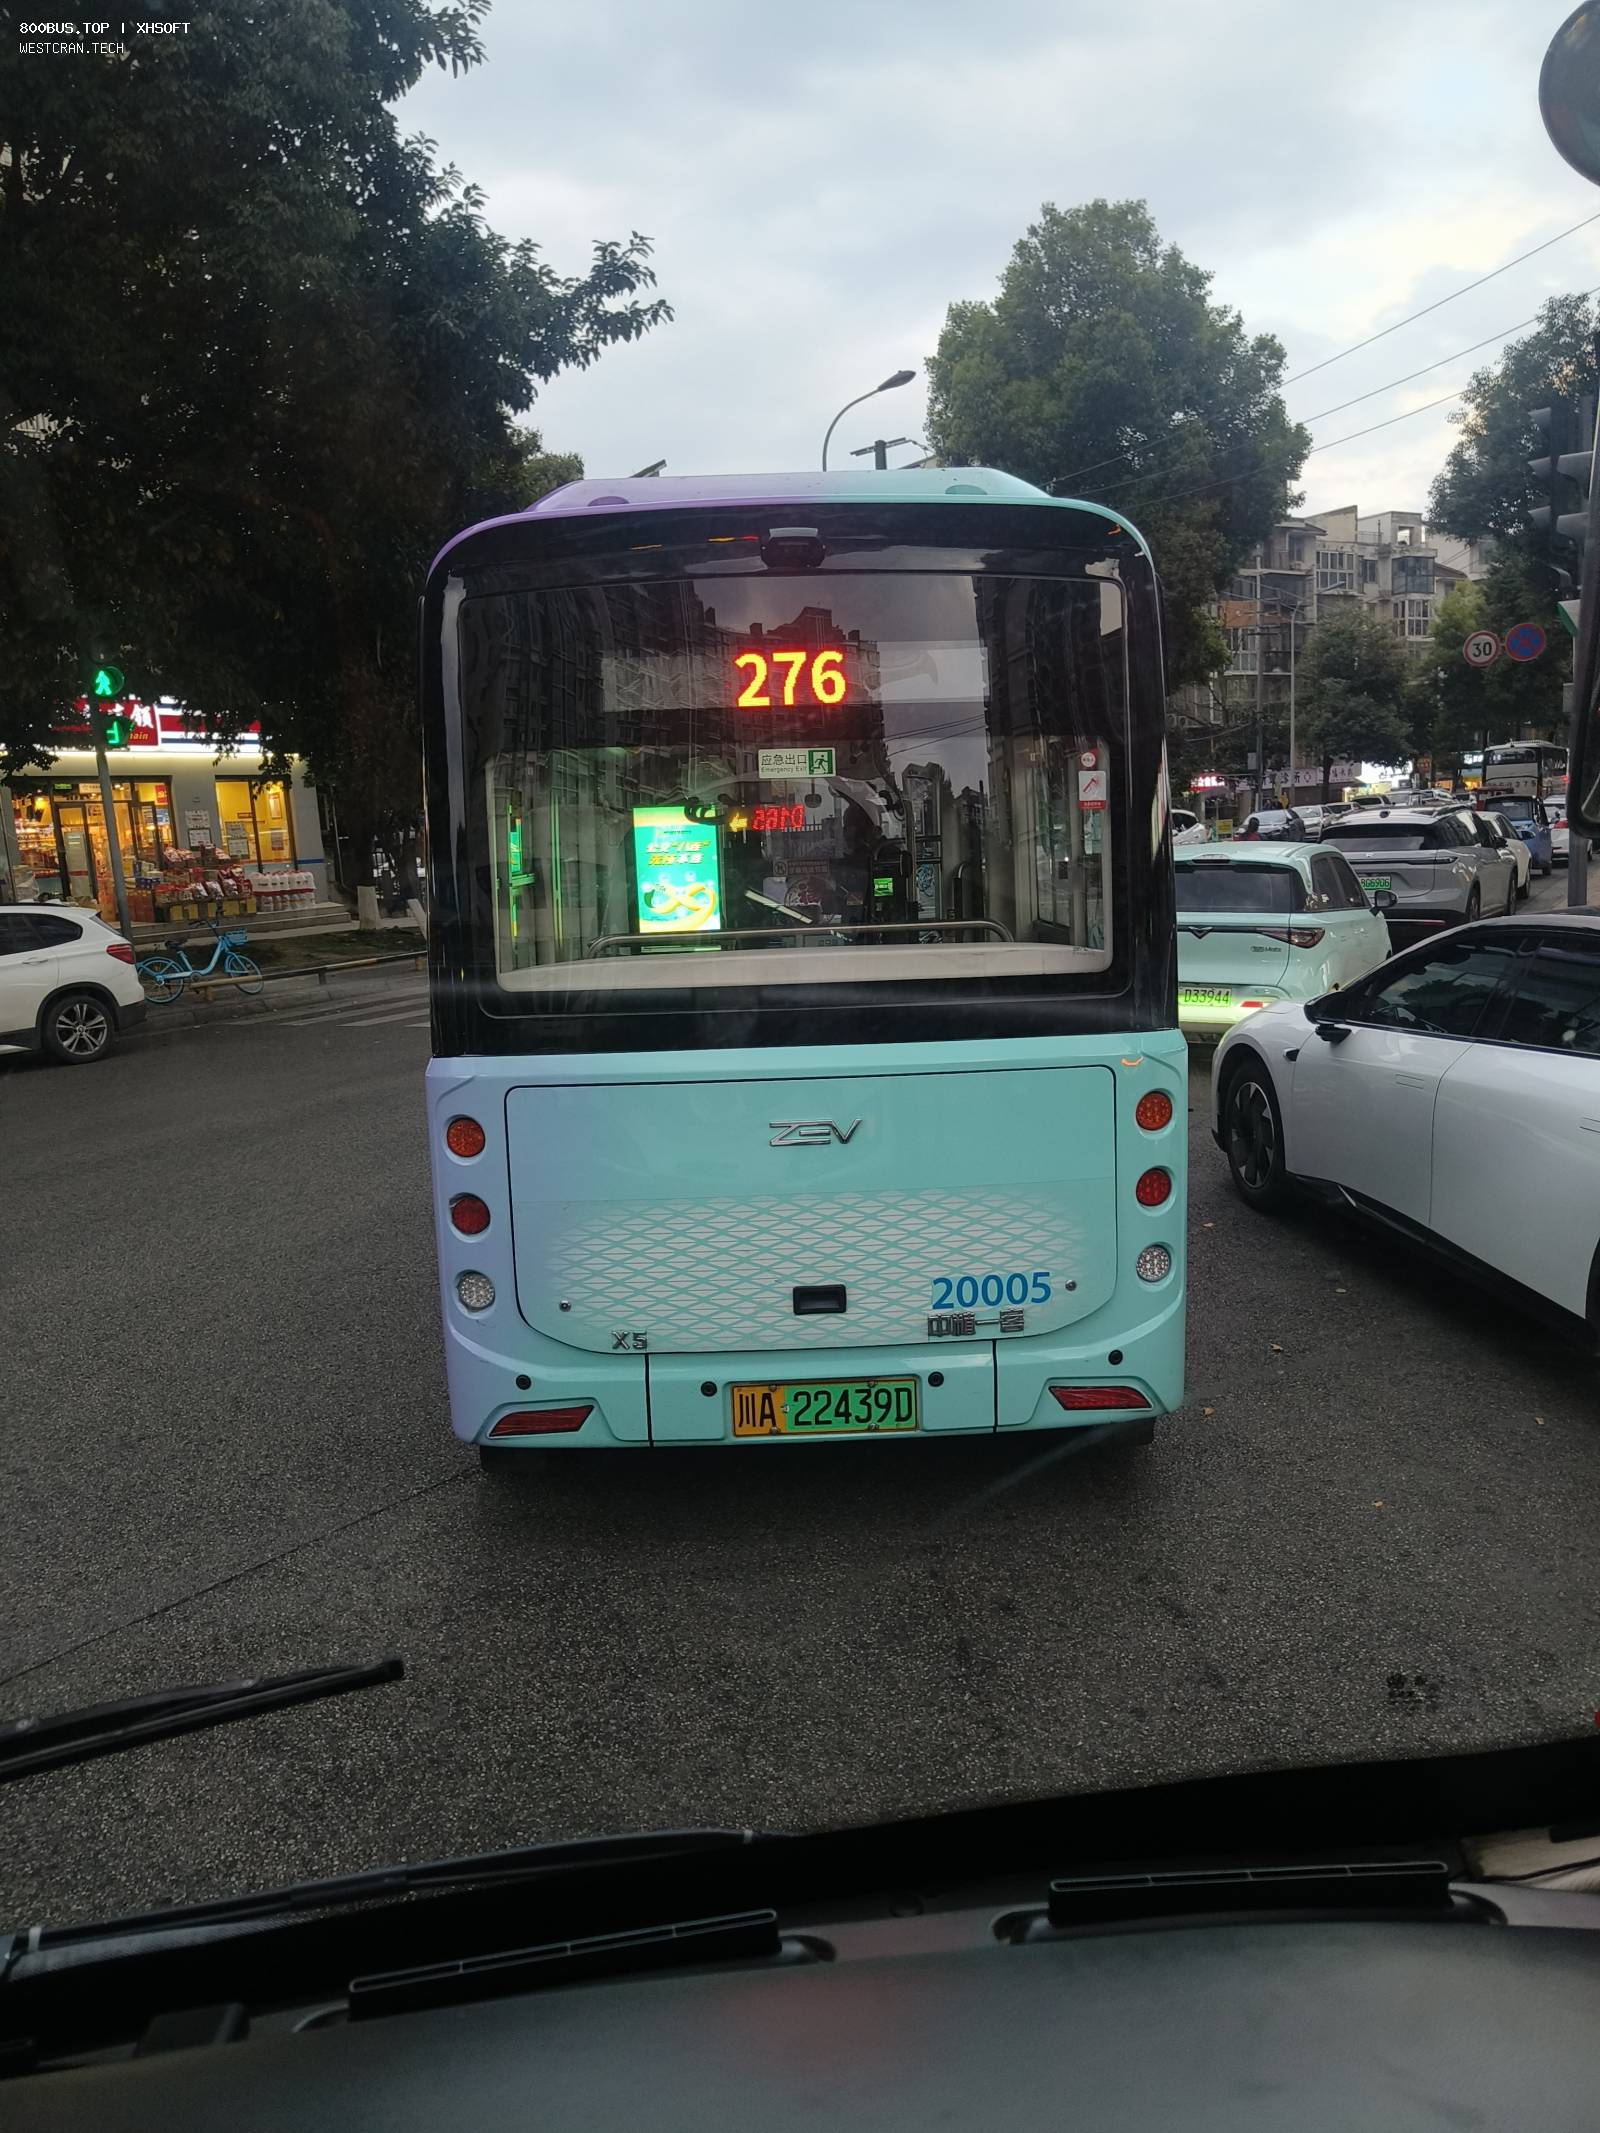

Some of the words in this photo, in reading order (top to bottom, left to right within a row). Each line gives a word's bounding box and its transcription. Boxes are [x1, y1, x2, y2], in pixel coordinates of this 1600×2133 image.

[1472, 641, 1493, 658] 30
[734, 650, 847, 707] 276
[761, 753, 807, 766] 应急出口
[760, 766, 794, 774] Emergency
[1184, 989, 1230, 1005] D33944
[769, 1119, 863, 1147] ZEV
[932, 1271, 1052, 1310] 20005
[611, 1331, 648, 1351] X5
